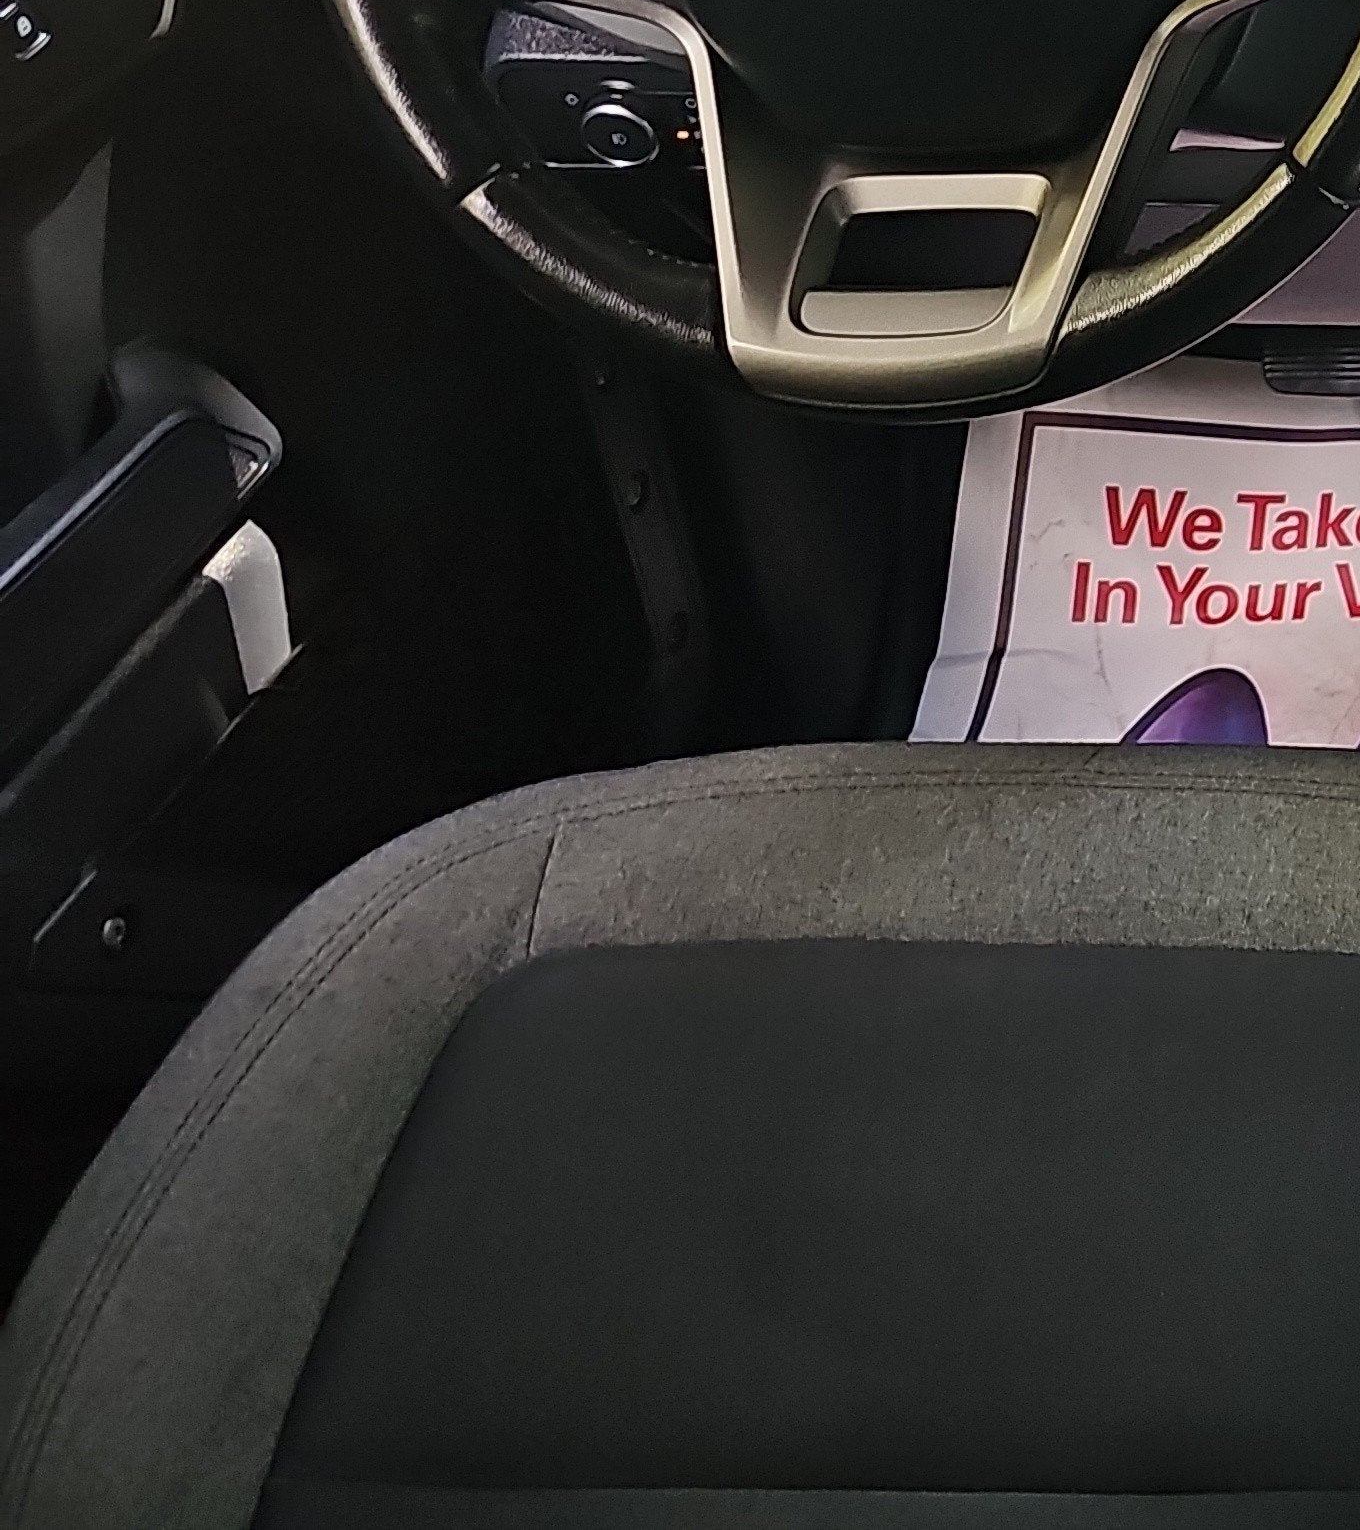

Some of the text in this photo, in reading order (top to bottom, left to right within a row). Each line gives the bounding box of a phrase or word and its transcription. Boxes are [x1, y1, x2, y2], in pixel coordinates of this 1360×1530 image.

[1104, 485, 1224, 552] We
[1070, 561, 1137, 624] In
[1155, 563, 1323, 626] Your
